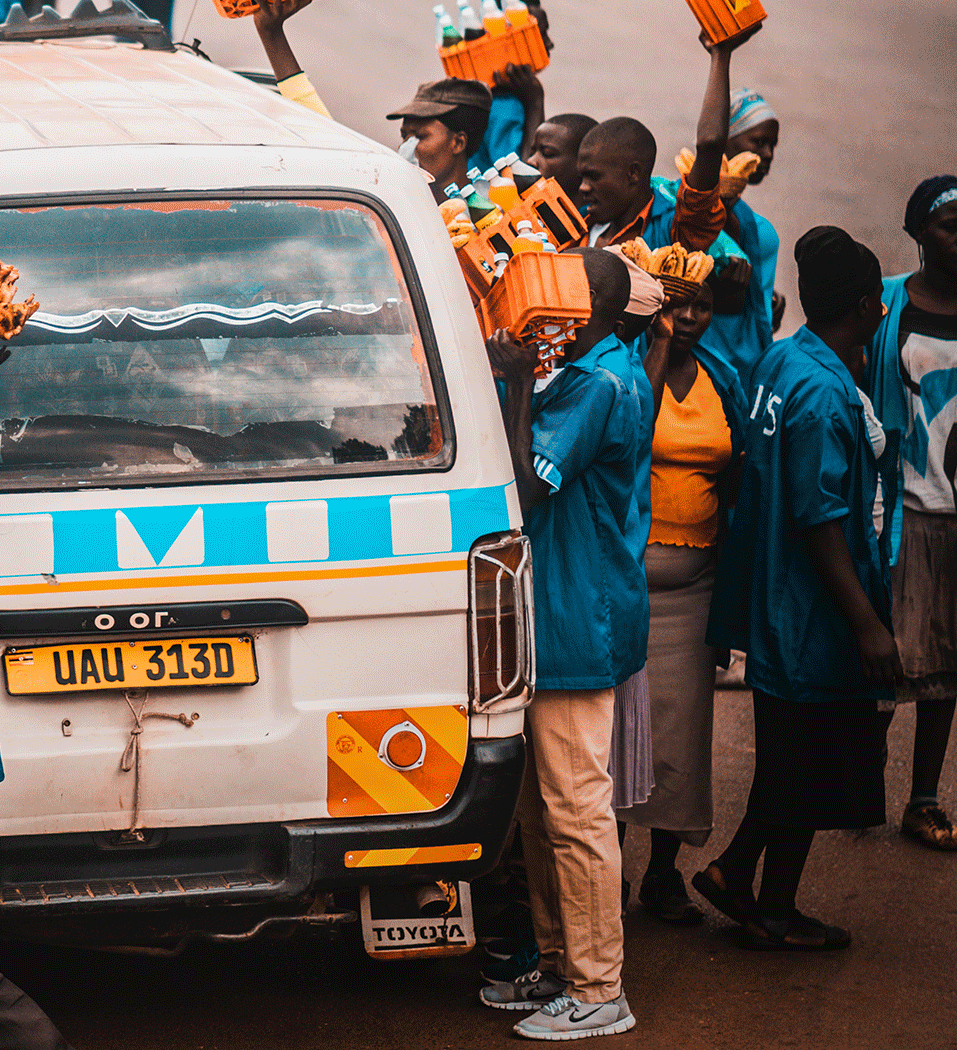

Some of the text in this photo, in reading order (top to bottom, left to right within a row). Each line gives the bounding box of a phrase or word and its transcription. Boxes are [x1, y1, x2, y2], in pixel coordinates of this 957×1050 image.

[53, 642, 235, 686] UAU 313D
[372, 923, 465, 942] TOYOTA
